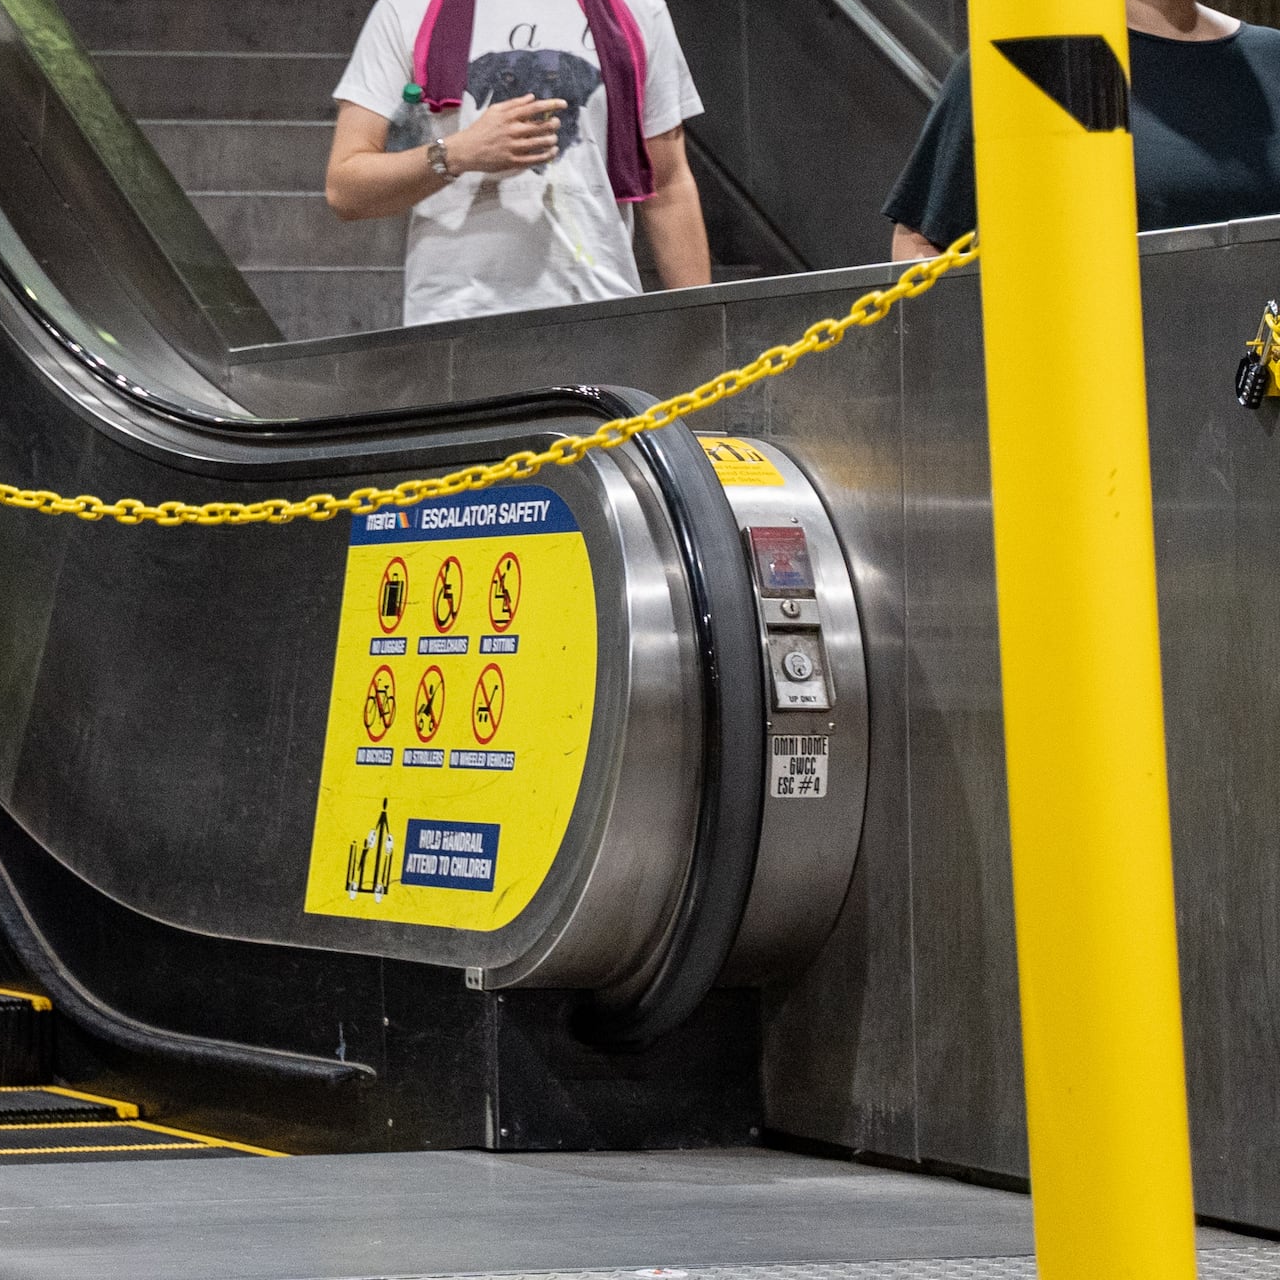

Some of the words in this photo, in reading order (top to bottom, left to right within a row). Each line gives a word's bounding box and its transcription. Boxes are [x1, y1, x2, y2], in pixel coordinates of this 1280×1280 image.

[366, 510, 396, 531] marta
[421, 503, 497, 530] ESCALATOR
[498, 500, 551, 525] SAFETY
[788, 695, 798, 703] UP
[800, 695, 817, 703] ONLY
[774, 737, 798, 756] OMNI
[801, 737, 827, 756] DOME
[777, 776, 795, 795] ESC
[797, 776, 821, 795] #4
[419, 829, 442, 850] HOLD
[442, 830, 484, 853] HANDRAIL
[405, 853, 438, 875] ATTEND
[438, 855, 450, 876] TO
[450, 856, 492, 880] CHILDREN
